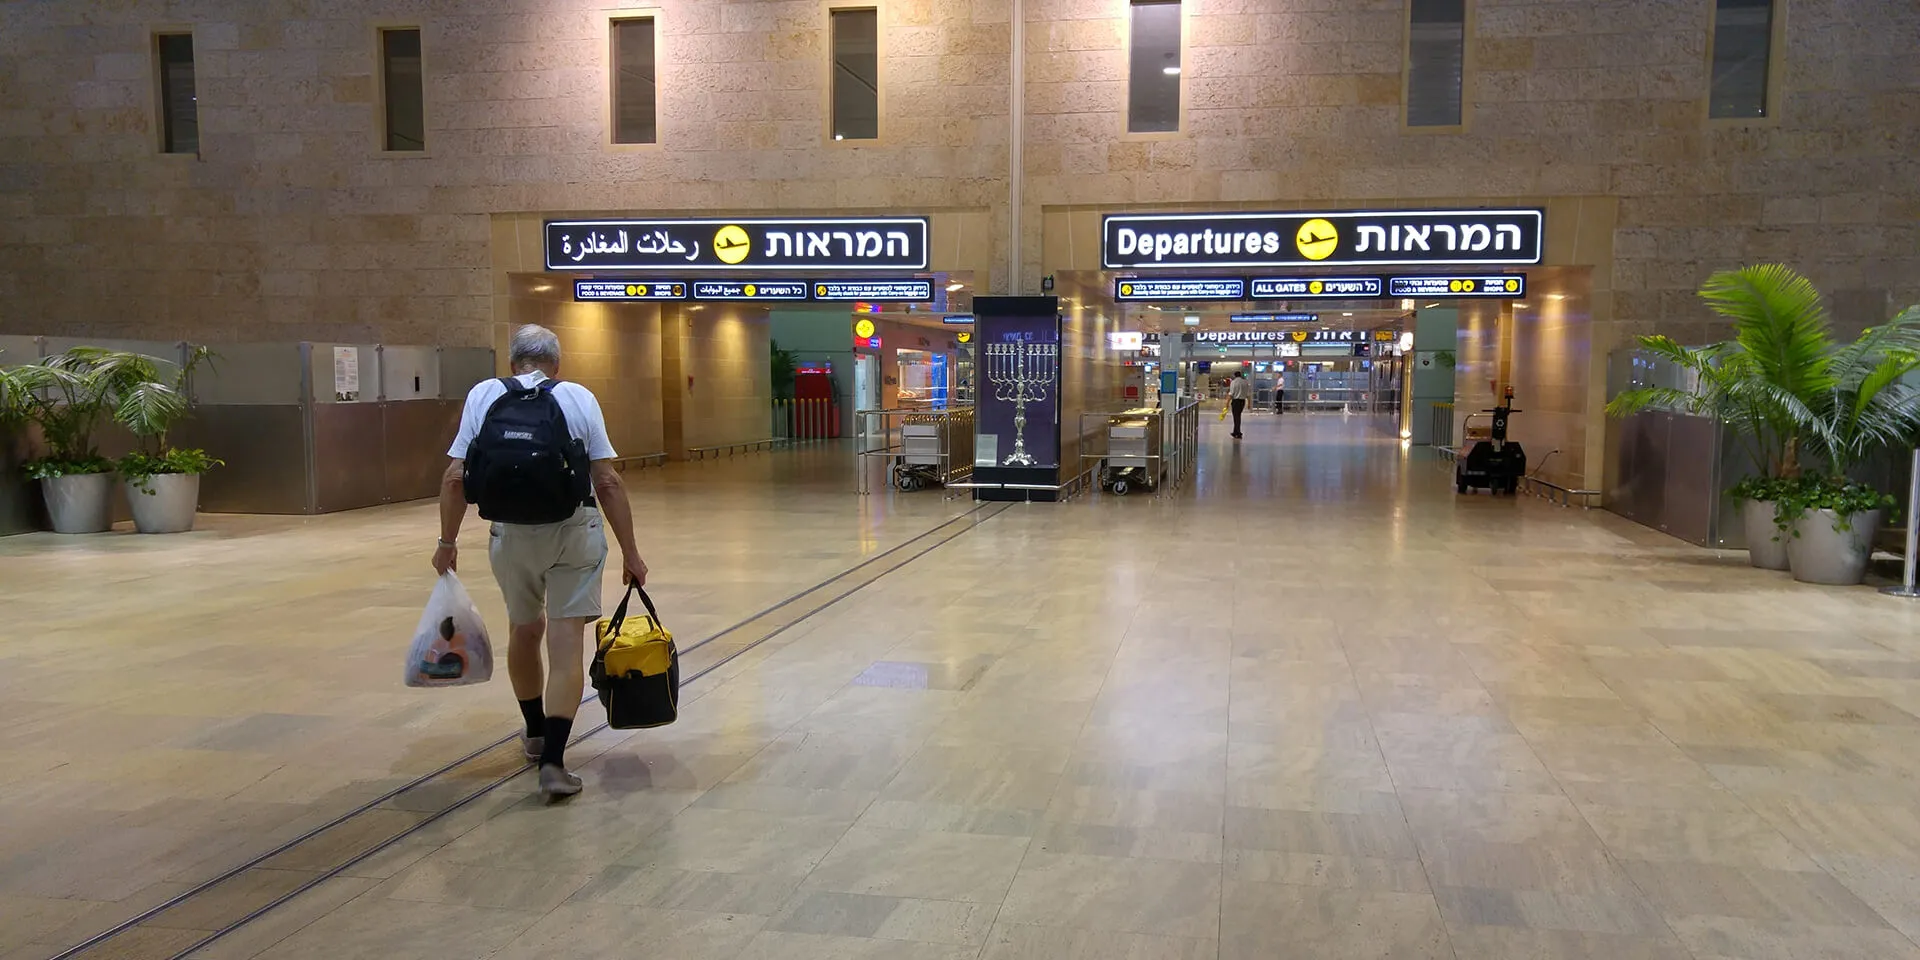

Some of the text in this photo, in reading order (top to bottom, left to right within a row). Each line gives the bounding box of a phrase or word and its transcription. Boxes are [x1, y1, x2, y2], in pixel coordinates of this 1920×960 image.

[562, 229, 700, 262] رحلات المغادرة
[765, 231, 910, 258] המראות
[1117, 228, 1280, 261] Departures
[1355, 223, 1522, 252] המראות
[759, 286, 803, 295] כל השערים
[1255, 283, 1307, 293] ALL GATES
[1325, 281, 1377, 293] כל השערים
[1196, 331, 1285, 343] Departures
